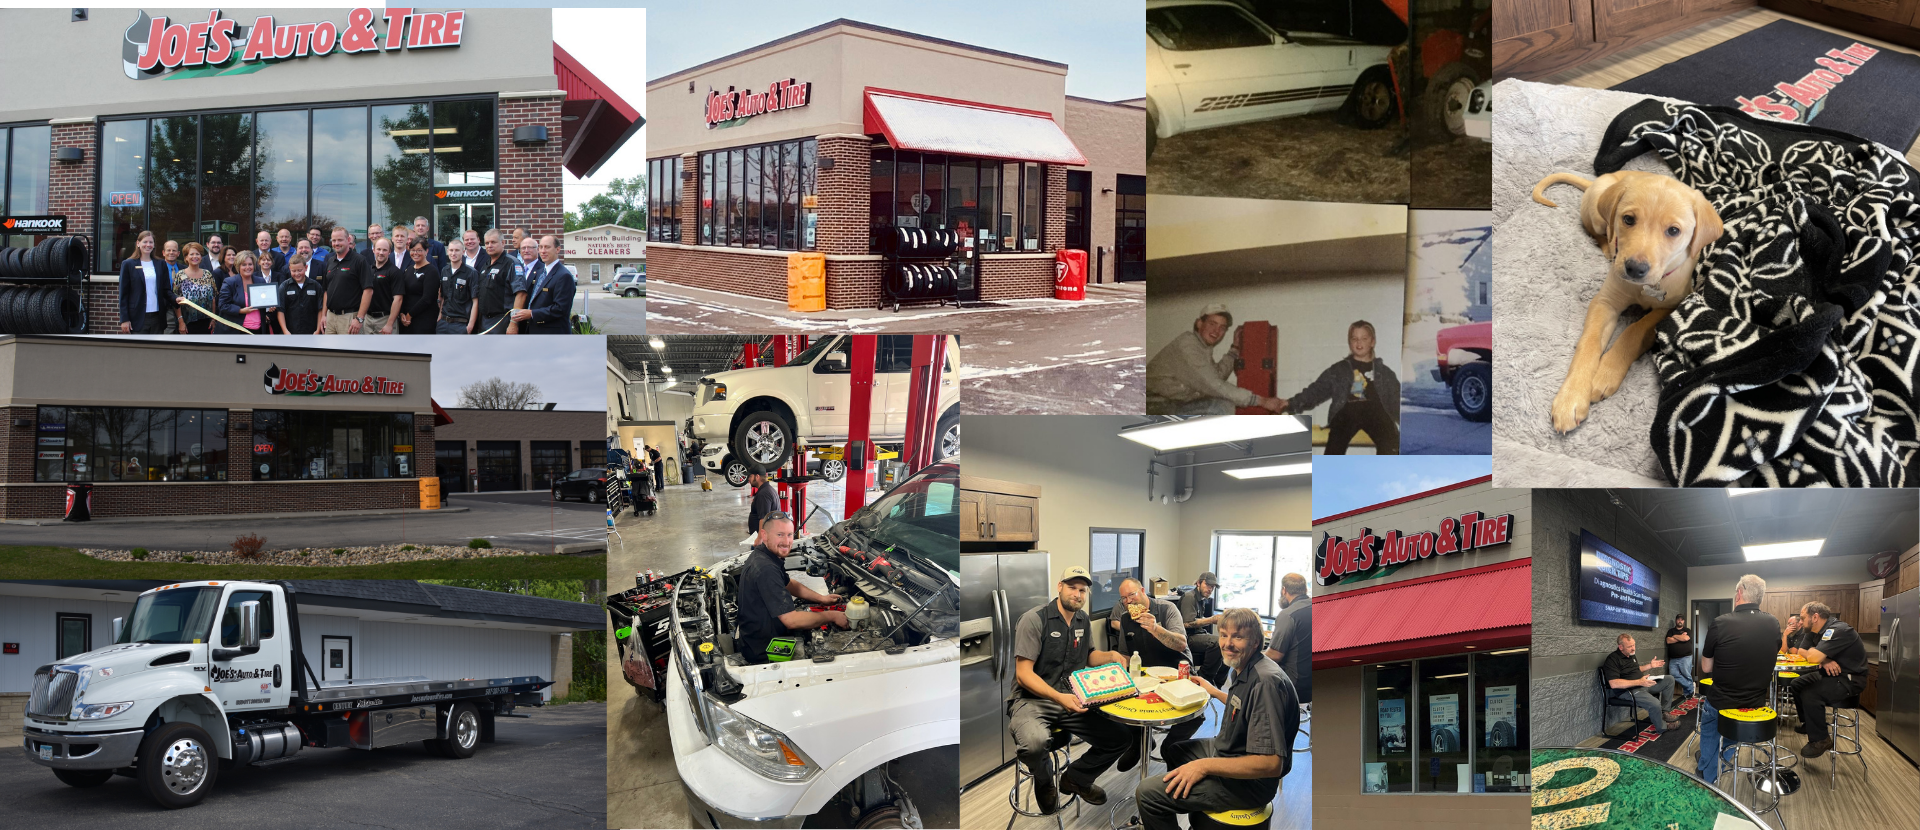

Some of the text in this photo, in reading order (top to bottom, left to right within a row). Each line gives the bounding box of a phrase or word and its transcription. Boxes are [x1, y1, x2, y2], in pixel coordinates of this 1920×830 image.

[137, 8, 465, 70] JOE'S AUTO & TIRE
[1774, 69, 1844, 108] AUTO
[1825, 42, 1880, 66] TIRE
[706, 80, 806, 123] JOE'S AUTO & TIRE
[111, 193, 140, 204] OPEN
[14, 219, 62, 228] Hankook
[274, 368, 404, 394] JOE'S AUTO & TIRE
[254, 444, 273, 452] OPEN
[1320, 512, 1508, 578] JOE'S AUTO & TIRE
[1594, 577, 1621, 591] Diagnostics
[214, 667, 235, 680] JOE'S
[237, 669, 252, 679] AUTO
[260, 669, 272, 678] TIRE
